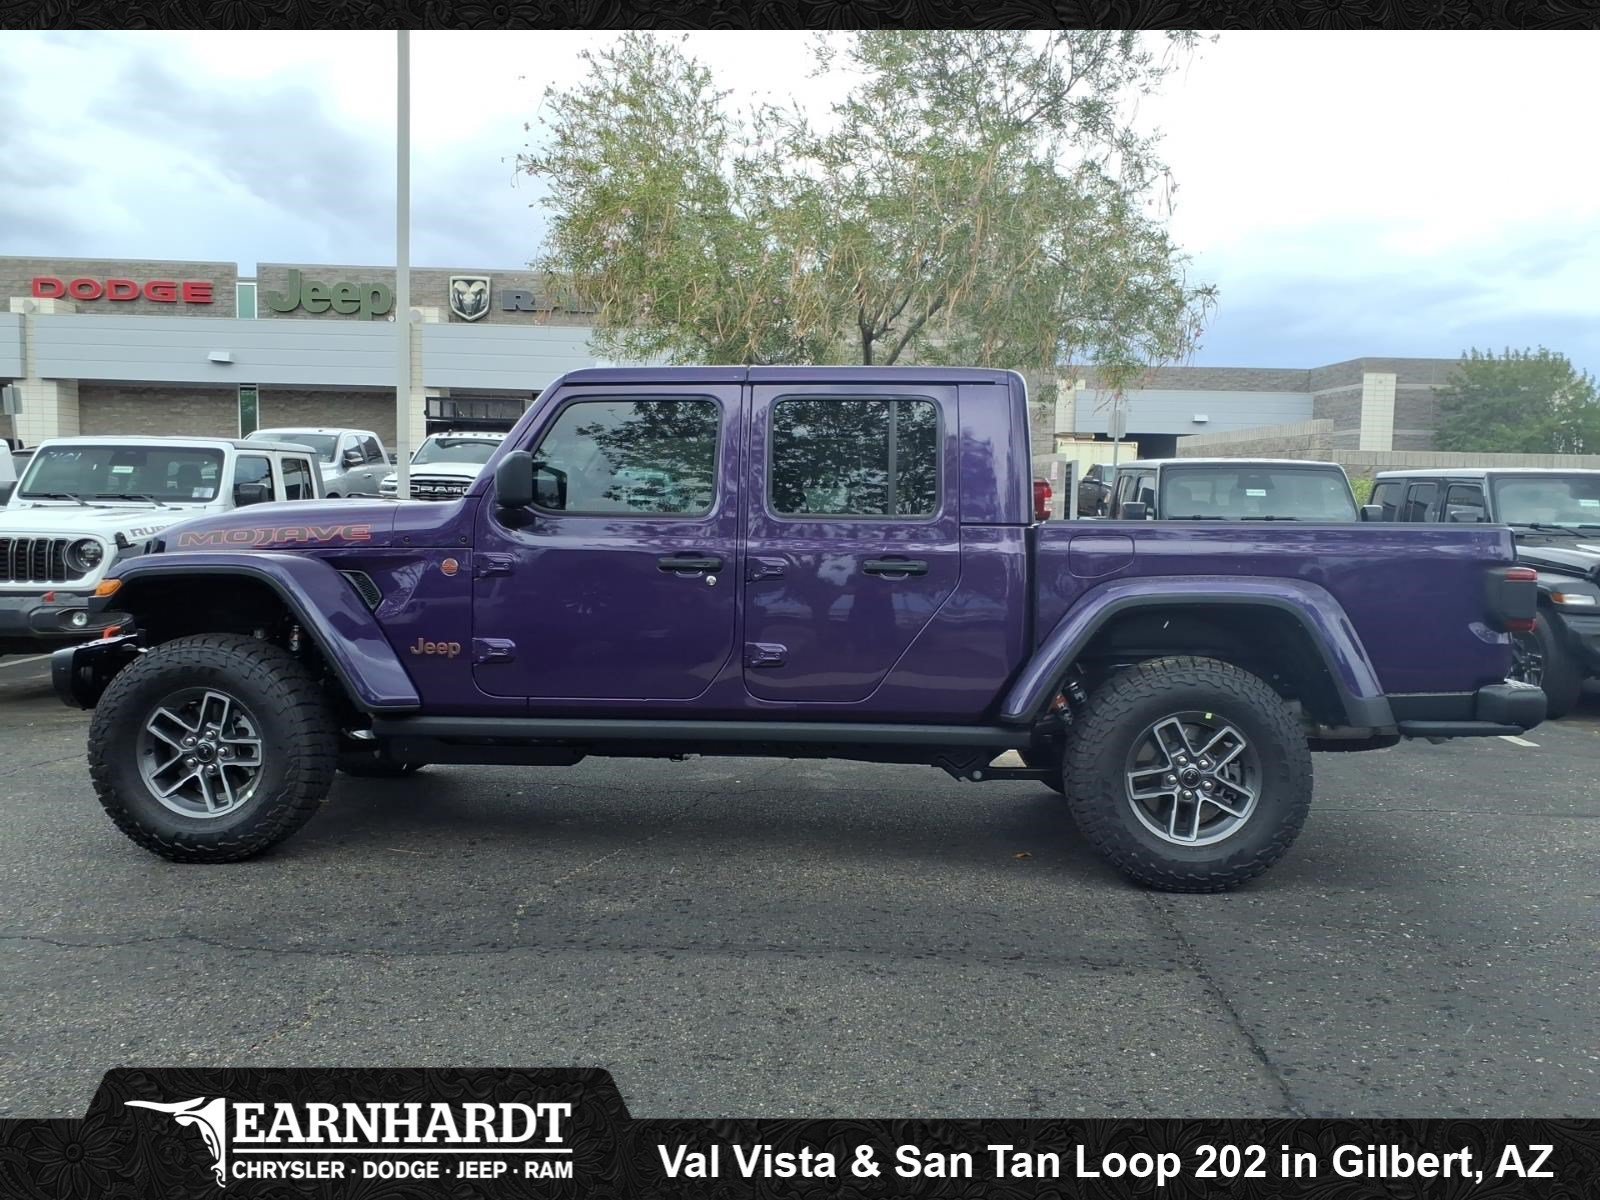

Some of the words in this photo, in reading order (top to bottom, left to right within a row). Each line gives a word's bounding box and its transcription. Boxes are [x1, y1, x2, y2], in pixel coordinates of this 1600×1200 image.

[32, 277, 214, 304] DODGE
[266, 268, 393, 321] Jeep
[420, 486, 463, 494] RAM
[177, 524, 372, 547] MOJAVE
[410, 637, 461, 659] Jeep
